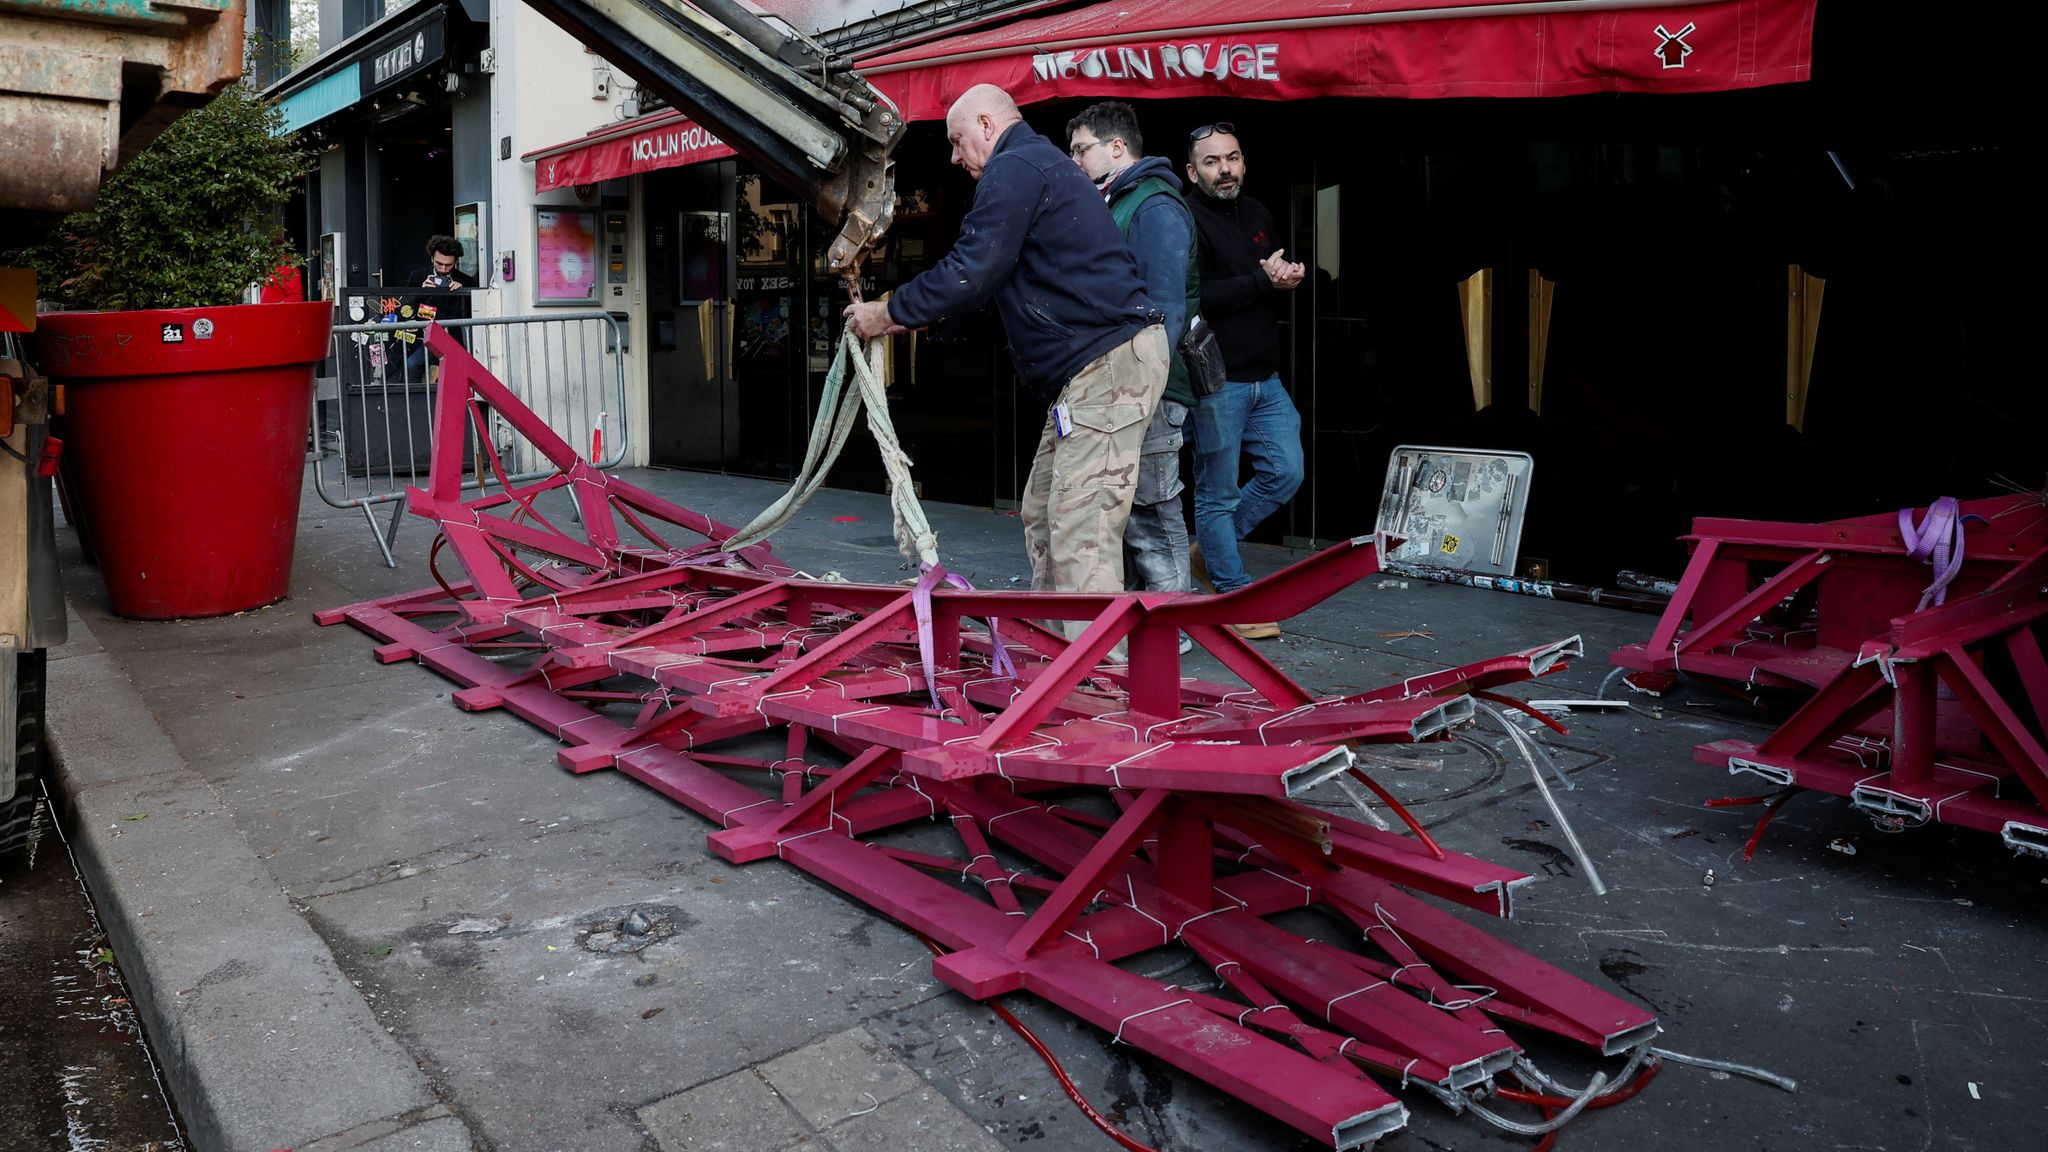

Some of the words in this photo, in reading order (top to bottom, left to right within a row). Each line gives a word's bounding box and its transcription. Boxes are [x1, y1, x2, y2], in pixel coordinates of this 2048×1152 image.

[1033, 47, 1154, 83] MOULIN
[1159, 42, 1280, 82] ROUGE
[632, 133, 679, 161] MOULIN
[163, 329, 183, 339] 21
